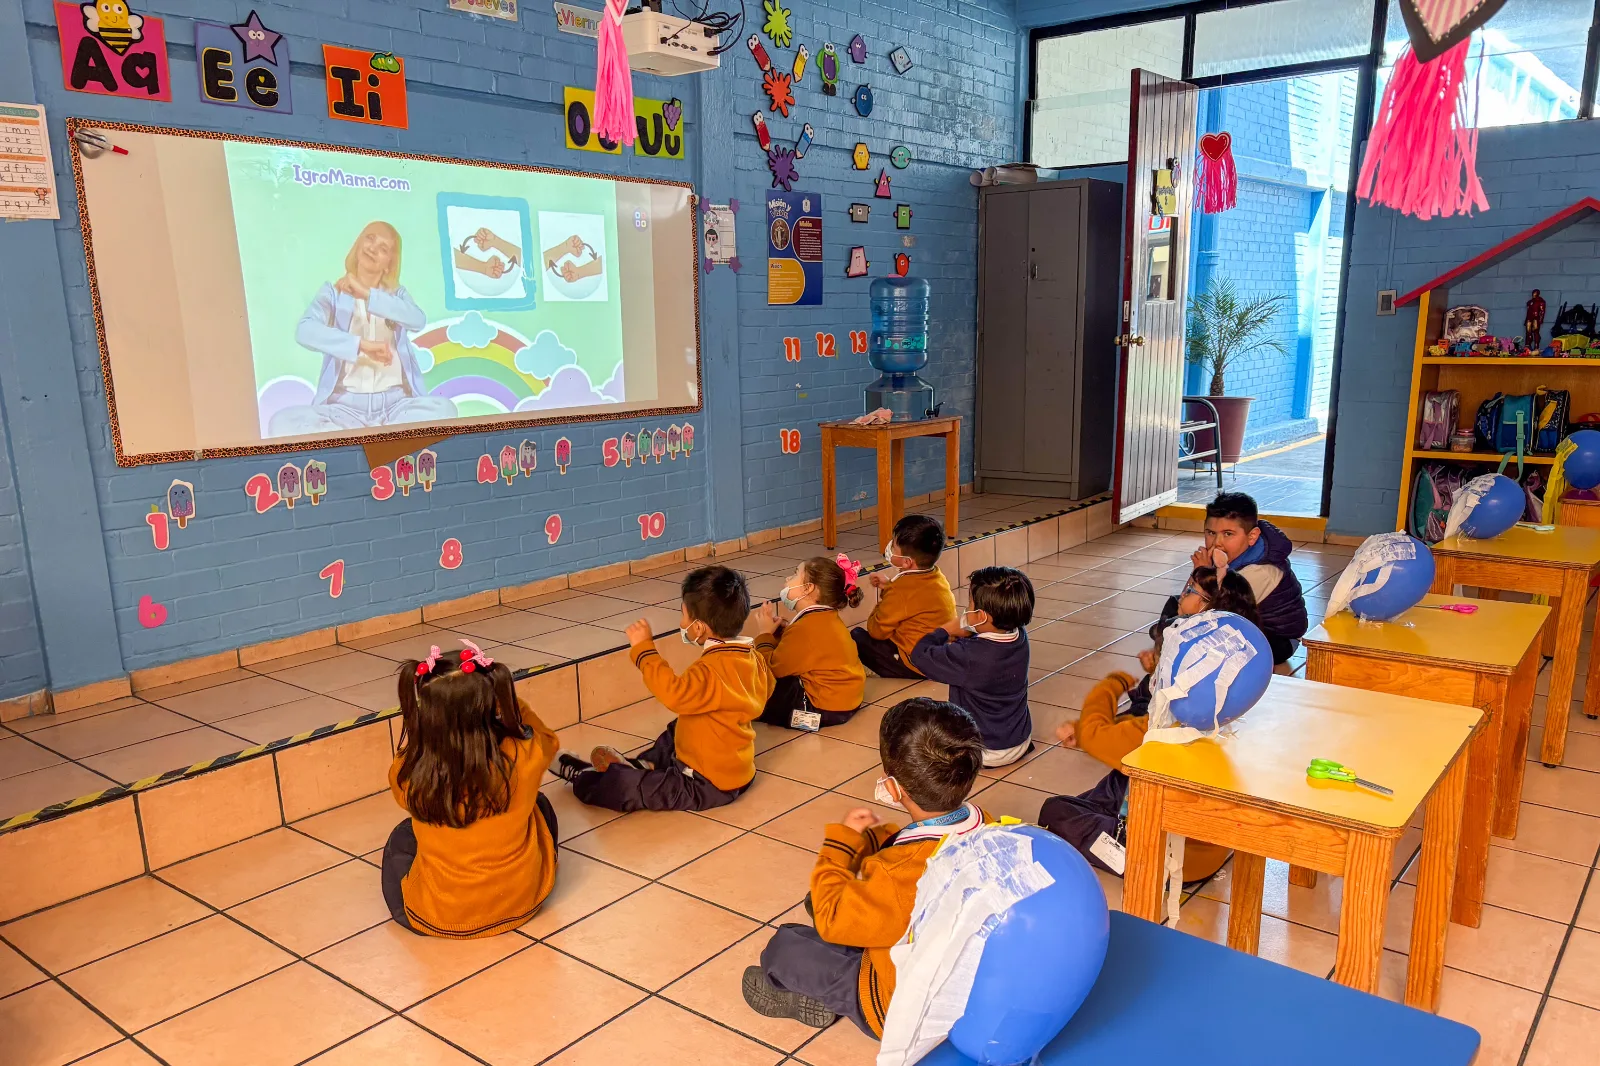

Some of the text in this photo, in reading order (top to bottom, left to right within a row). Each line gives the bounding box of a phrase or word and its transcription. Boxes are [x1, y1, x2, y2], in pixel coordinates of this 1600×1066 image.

[560, 8, 600, 31] Viern
[201, 46, 280, 108] Ee
[330, 66, 383, 121] Ii
[635, 113, 681, 156] Uu
[292, 164, 411, 191] IgroMama.com
[783, 337, 801, 362] 11
[816, 332, 836, 357] 12
[849, 330, 868, 354] 13
[602, 438, 620, 467] 5
[780, 428, 801, 453] 18
[370, 466, 395, 500] 3
[477, 454, 498, 484] 4
[245, 473, 280, 514] 2
[146, 512, 169, 550] 1
[545, 514, 563, 544] 9
[638, 511, 666, 540] 10
[439, 538, 463, 569] 8
[319, 559, 344, 598] 7
[138, 594, 168, 629] 6
